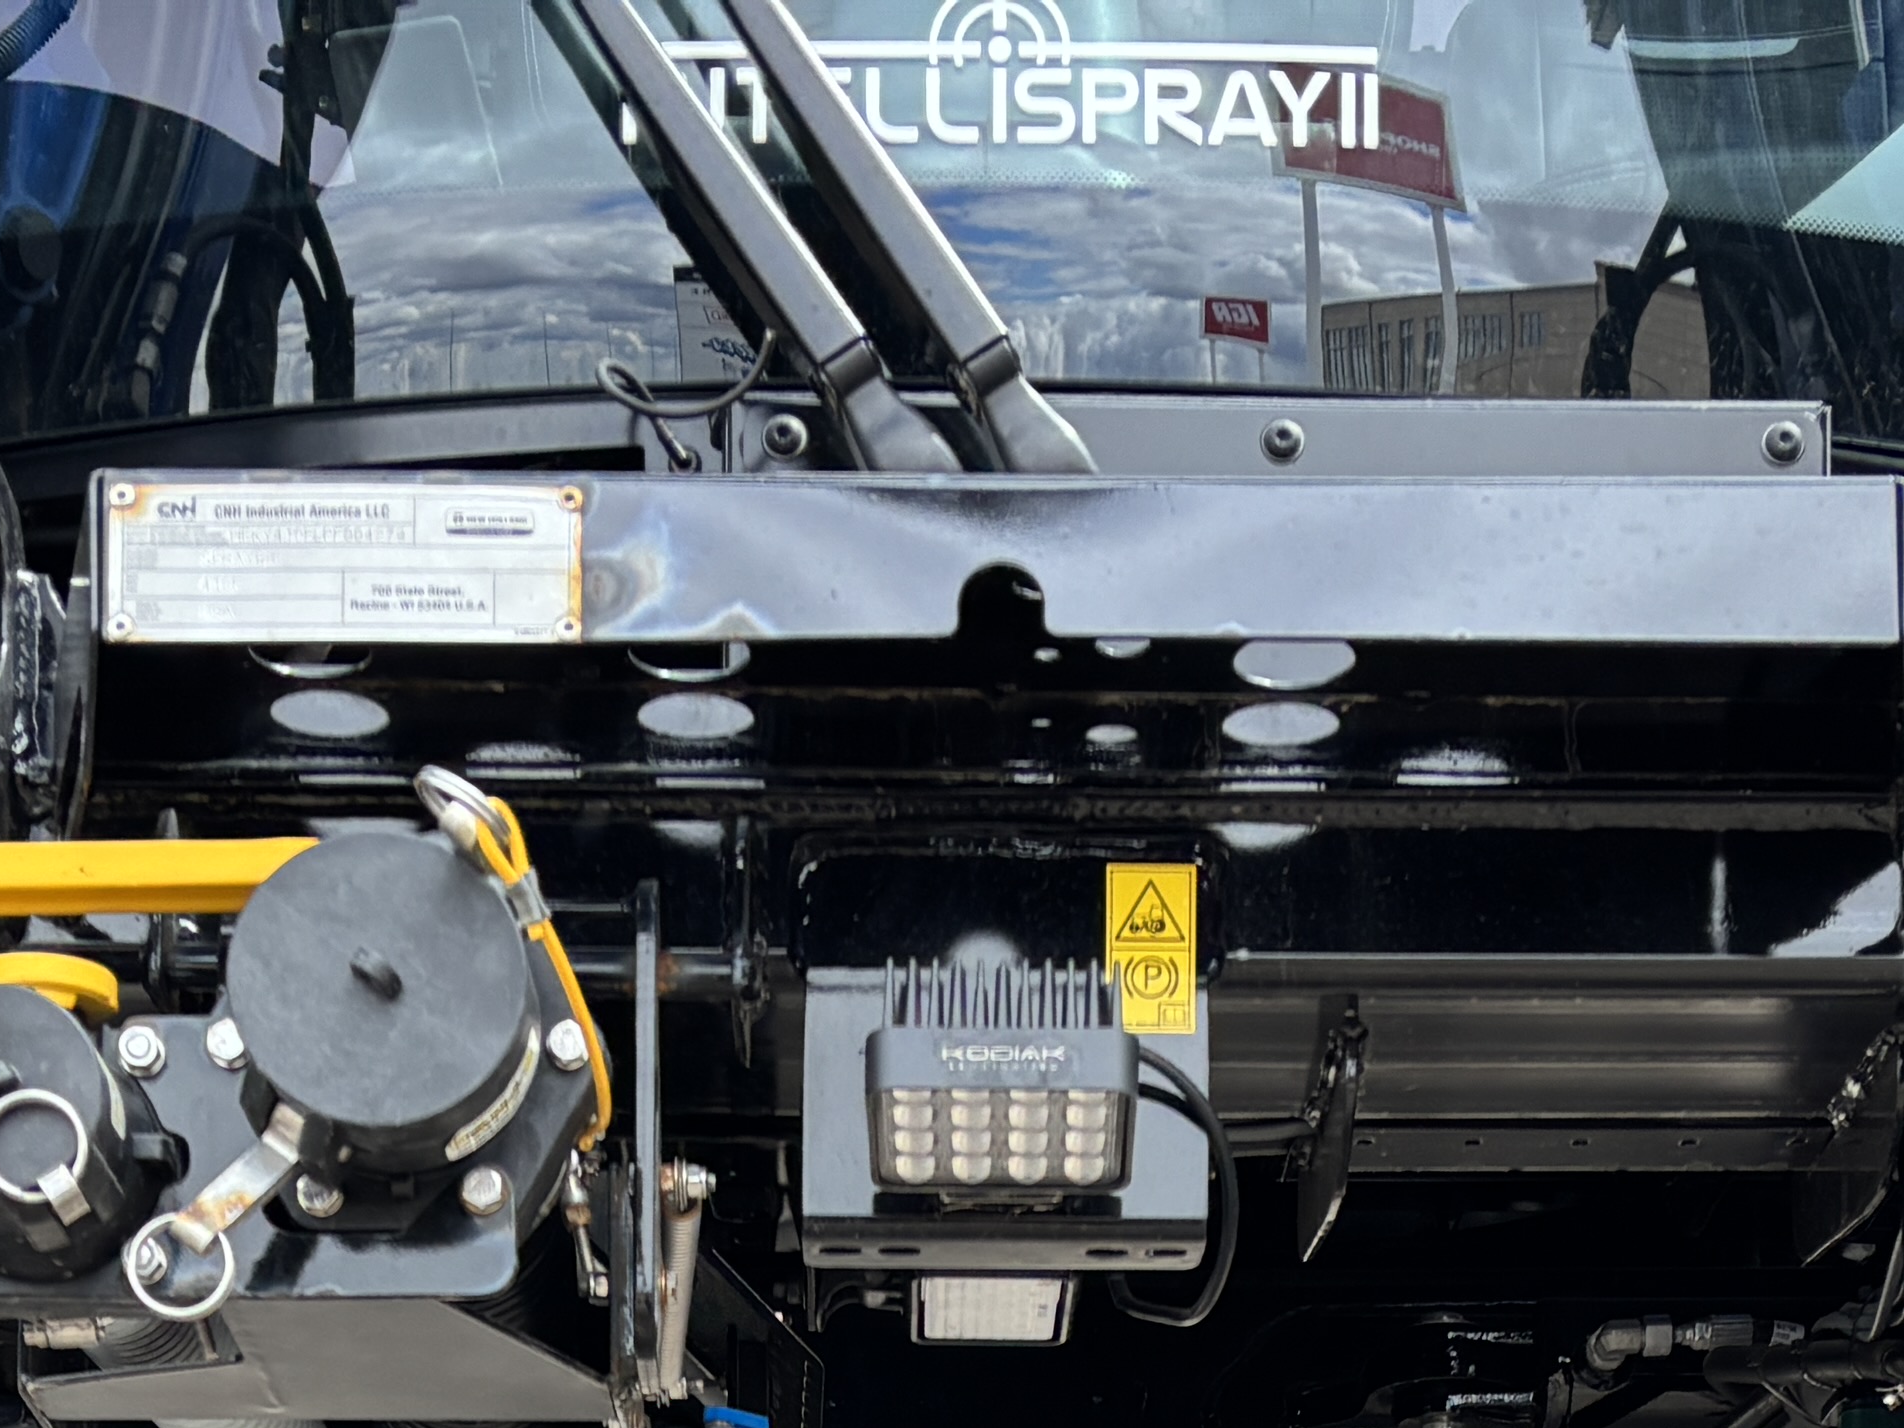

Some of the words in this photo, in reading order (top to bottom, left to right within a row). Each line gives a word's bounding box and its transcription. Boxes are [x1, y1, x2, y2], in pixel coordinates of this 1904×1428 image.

[157, 496, 197, 520] CNH
[214, 503, 242, 519] CNH
[245, 503, 305, 519] Industrial
[309, 503, 362, 519] America
[365, 503, 390, 519] LLC
[942, 1044, 1066, 1062] KODIAK
